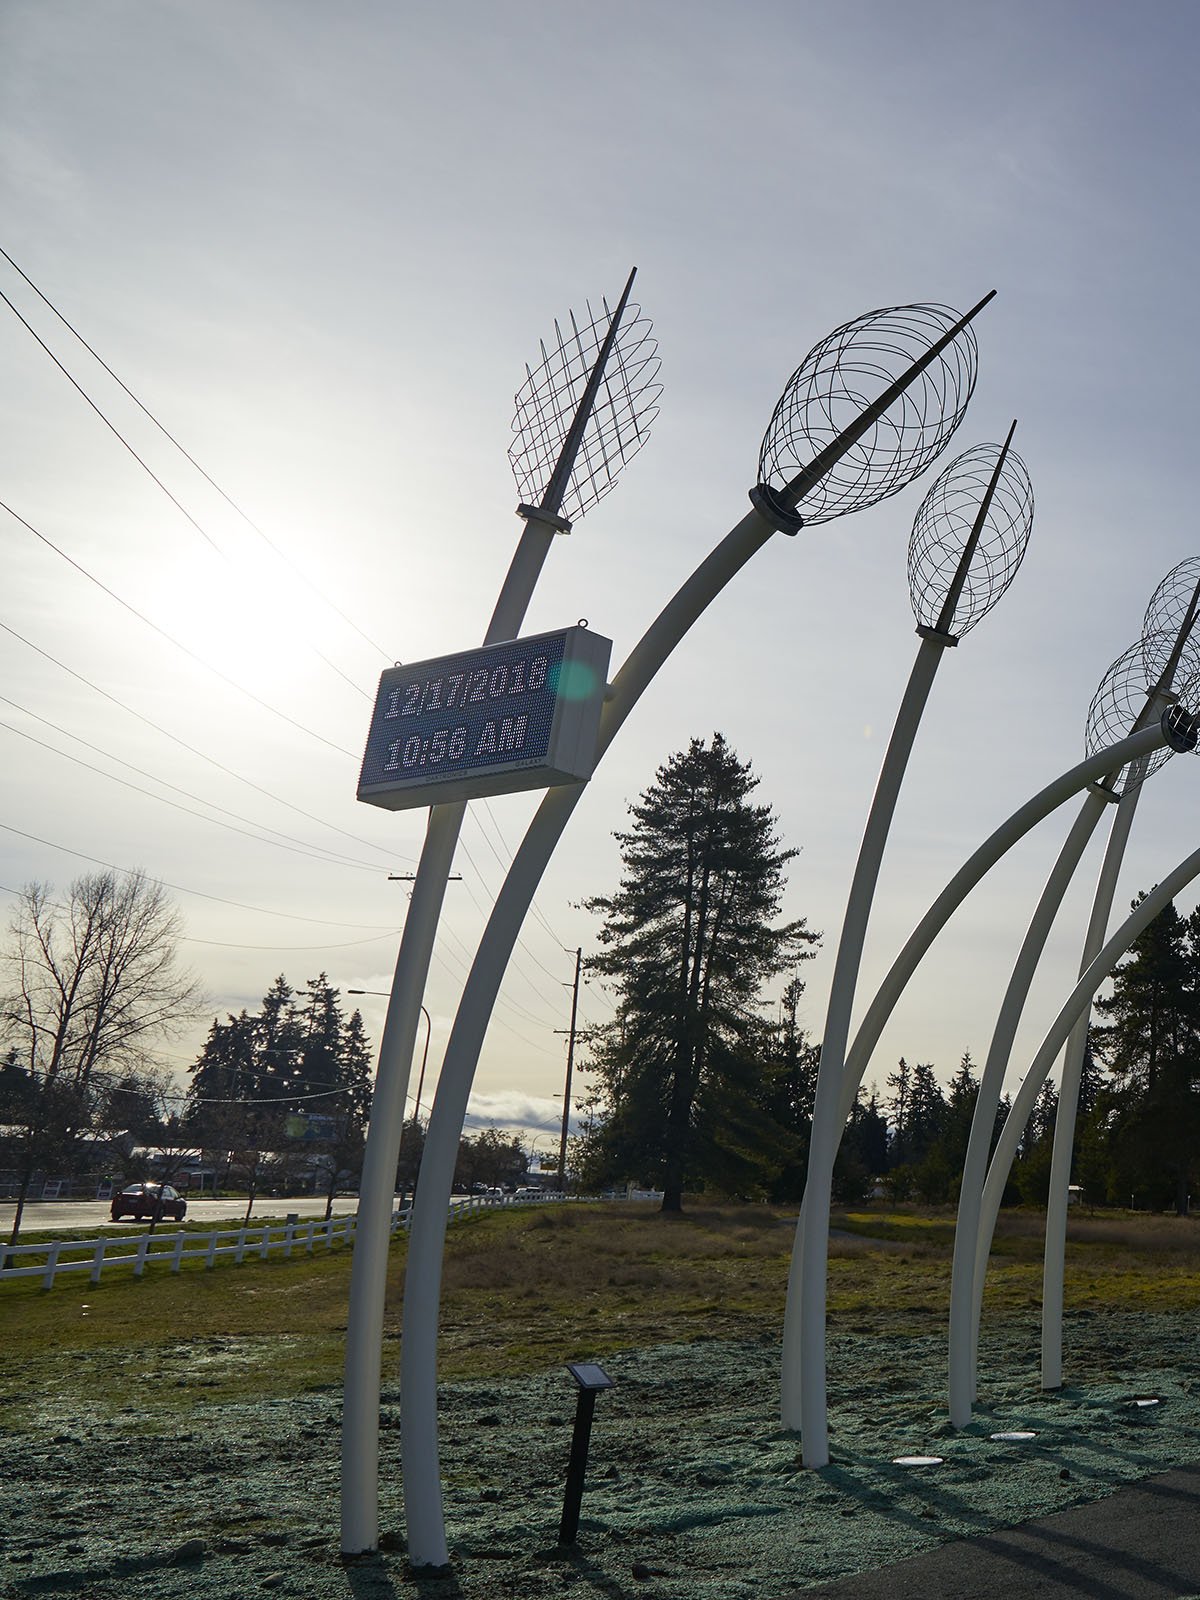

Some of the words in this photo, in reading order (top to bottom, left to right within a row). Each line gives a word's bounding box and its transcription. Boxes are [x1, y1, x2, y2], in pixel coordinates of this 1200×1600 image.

[384, 656, 548, 719] 12/17/2018
[384, 727, 467, 771] 10:56
[474, 715, 528, 755] AM
